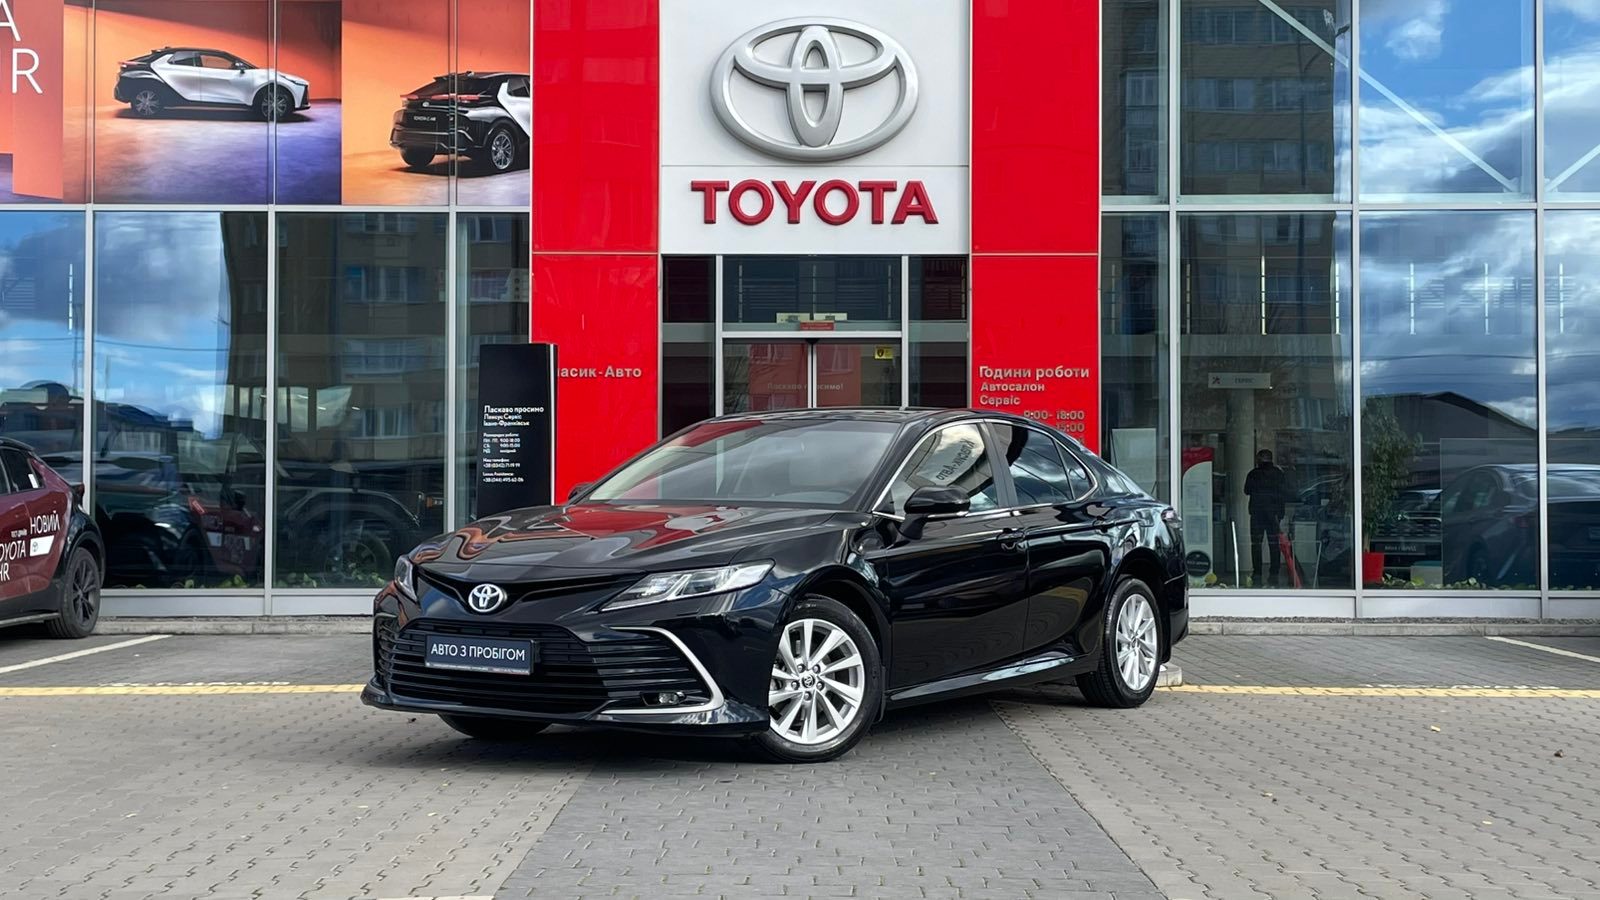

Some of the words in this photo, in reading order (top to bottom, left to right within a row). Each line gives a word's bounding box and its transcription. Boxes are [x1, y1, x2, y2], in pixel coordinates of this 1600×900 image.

[691, 179, 938, 226] TOYOTA
[557, 364, 642, 378] асик-Авто
[979, 365, 1031, 379] Години
[1035, 365, 1089, 380] роботи
[980, 382, 1045, 391] Автосалон
[980, 395, 1020, 406] Сервіс
[484, 405, 513, 413] Ласкаво
[30, 510, 60, 534] НОВИЙ
[431, 643, 458, 656] АВТО
[460, 646, 467, 656] З
[469, 645, 525, 661] ПРОБІГОМ
